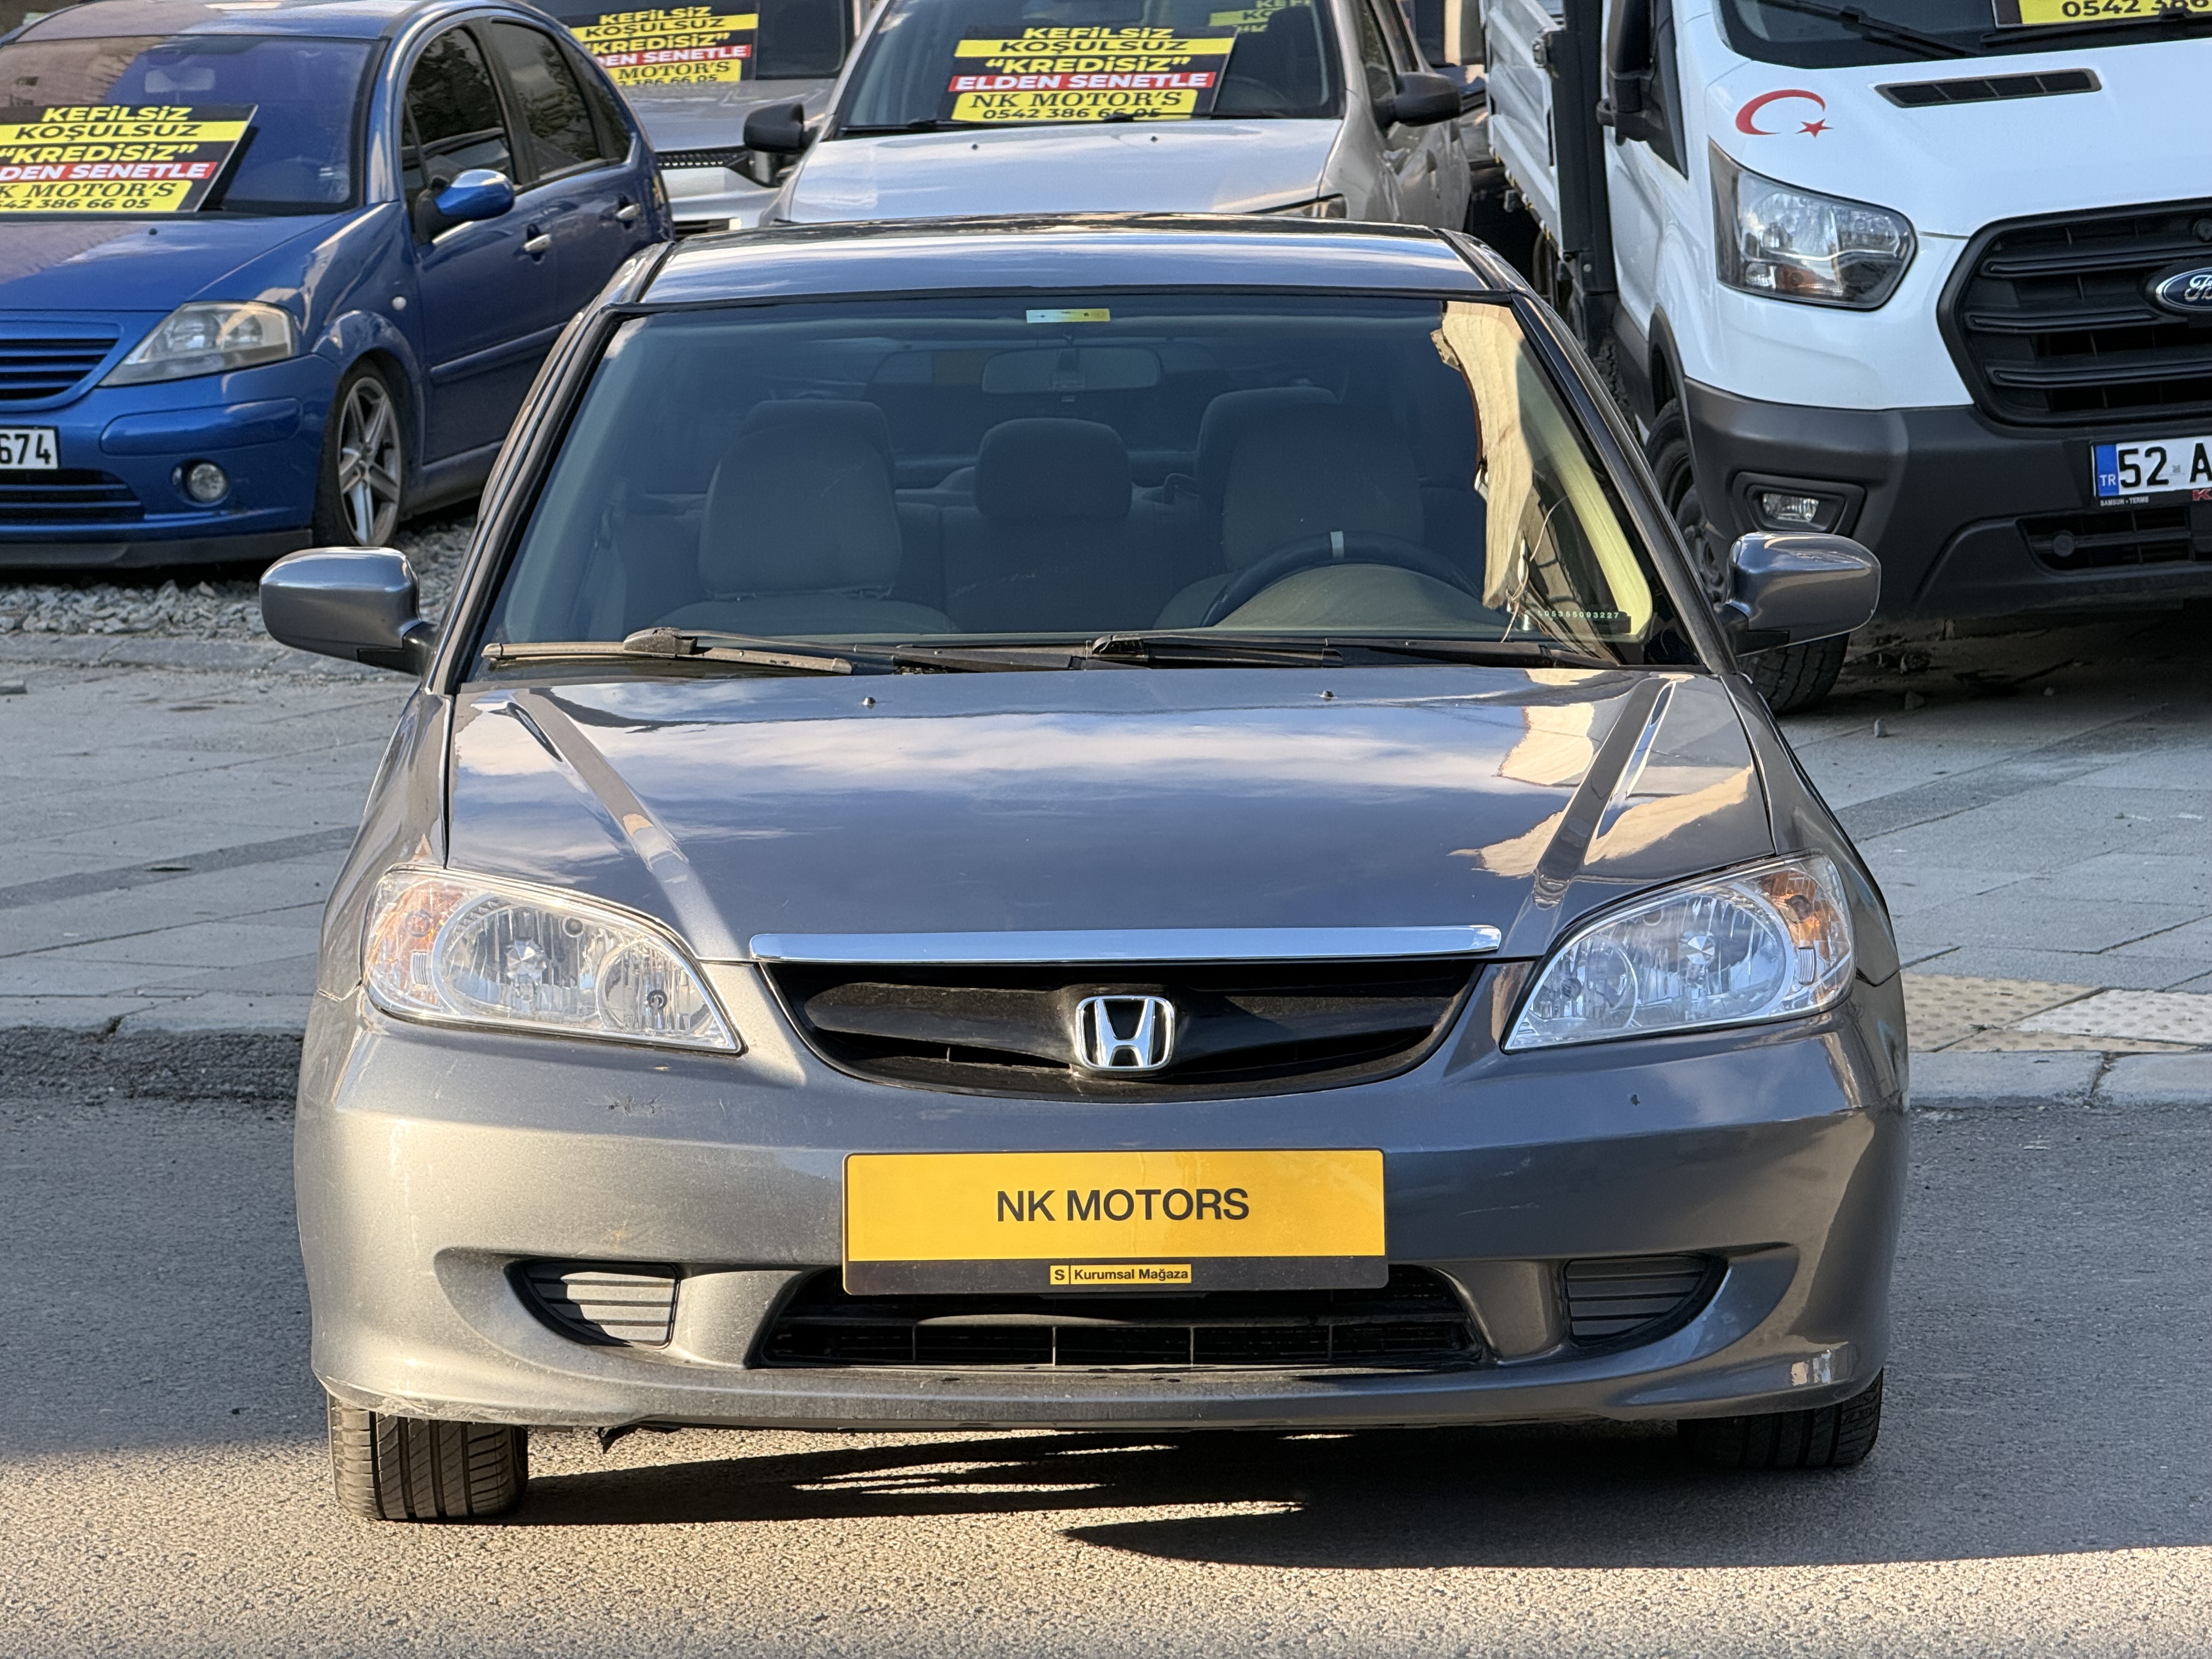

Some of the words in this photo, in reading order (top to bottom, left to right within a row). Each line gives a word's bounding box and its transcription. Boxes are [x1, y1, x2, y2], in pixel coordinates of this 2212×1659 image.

[2062, 0, 2141, 17] 0542
[586, 18, 724, 37] KOŞULSUZ
[642, 45, 747, 63] SENETLE
[1000, 41, 1189, 54] KOŞULSUZ
[955, 75, 1062, 89] ELDEN
[1068, 73, 1209, 88] SENETLE
[969, 94, 1020, 108] NK
[1028, 92, 1182, 106] MOTOR'S
[983, 109, 1040, 119] 0542
[1046, 108, 1091, 118] 386
[15, 124, 202, 141] KOŞULSUZ
[69, 163, 210, 179] SENETLE
[23, 183, 177, 198] MOTOR'S
[36, 199, 81, 208] 386
[86, 199, 116, 208] 66
[122, 198, 152, 208] 05
[0, 434, 51, 464] 674
[2100, 474, 2117, 487] TR
[2118, 446, 2169, 488] 52
[2190, 442, 2212, 483] A
[2100, 499, 2125, 507] SAMSUN
[1544, 610, 1619, 619] 05355093227
[997, 1190, 1056, 1222] NK
[1067, 1188, 1249, 1221] MOTORS
[1054, 1269, 1065, 1281] S
[1074, 1268, 1135, 1280] Kurumsal
[1139, 1268, 1188, 1282] Mağaza
